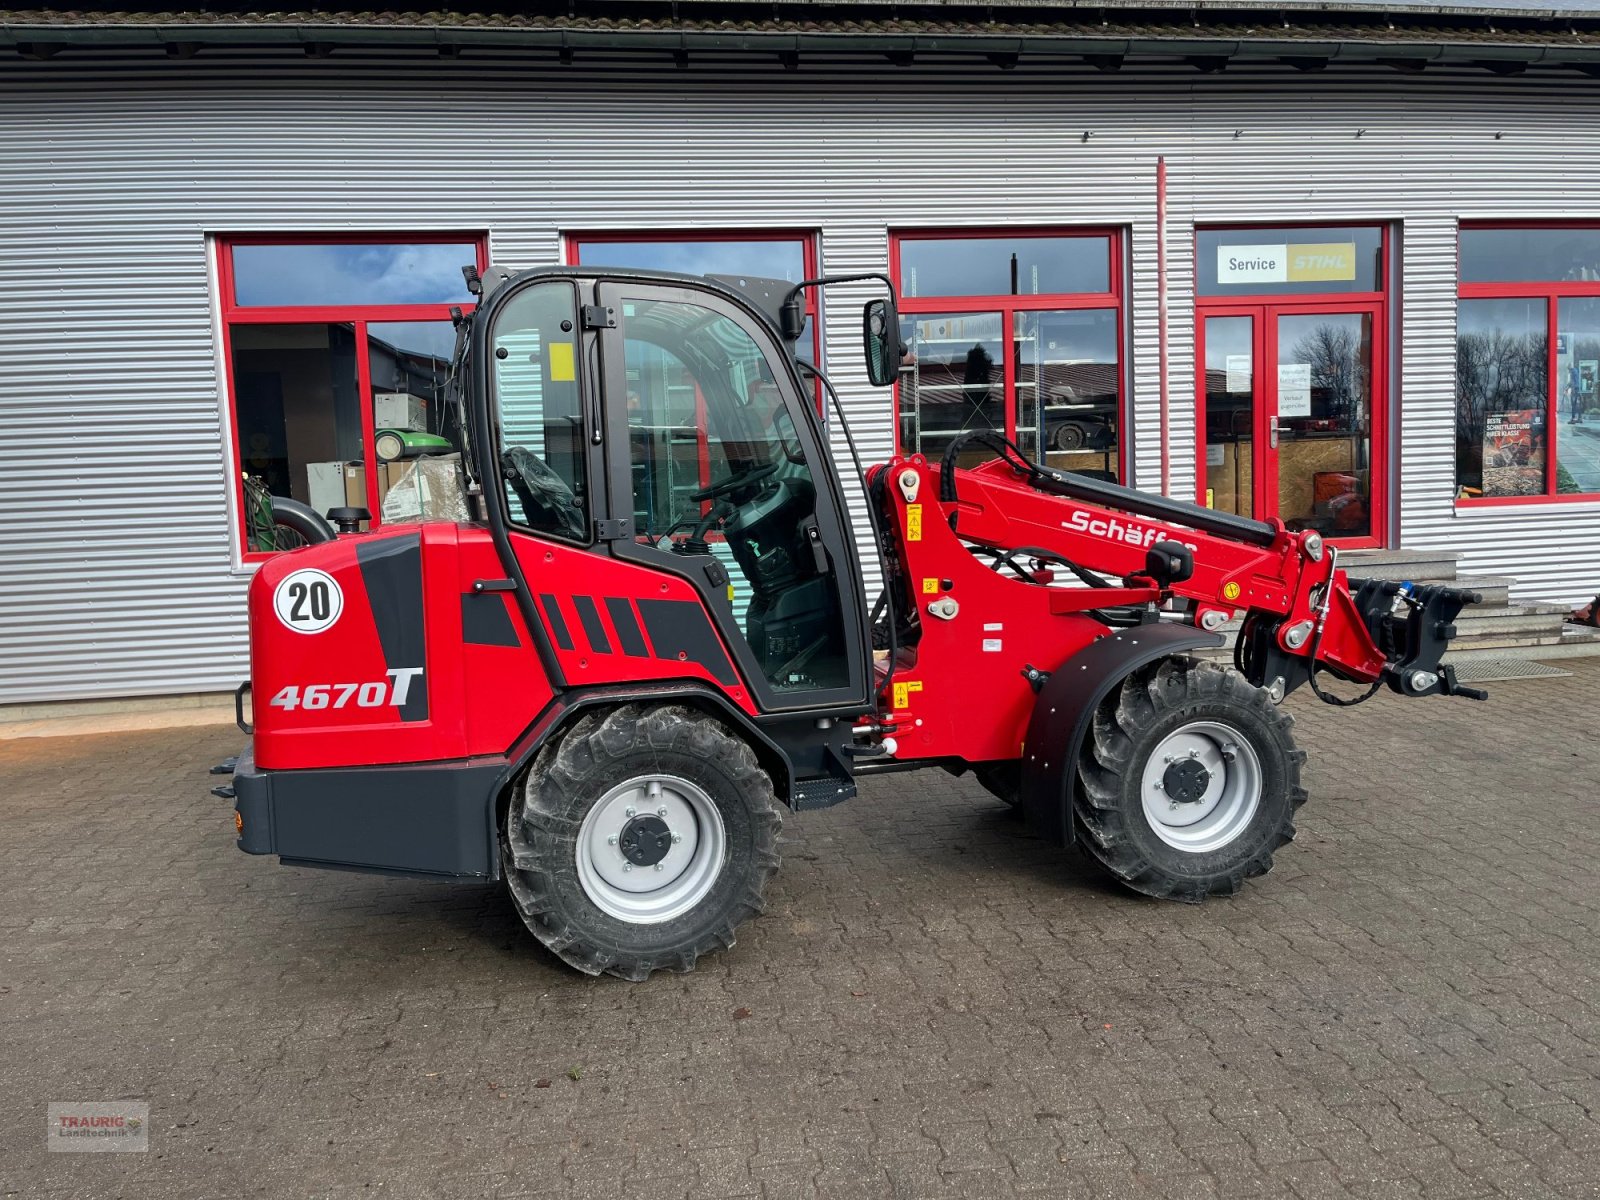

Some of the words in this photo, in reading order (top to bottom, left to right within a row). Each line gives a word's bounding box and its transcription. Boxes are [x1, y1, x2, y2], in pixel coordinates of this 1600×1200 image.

[1229, 257, 1276, 271] Service
[1294, 255, 1346, 269] STIHL
[1061, 510, 1198, 552] Schäff
[289, 581, 330, 621] 20
[269, 667, 424, 711] 4670T
